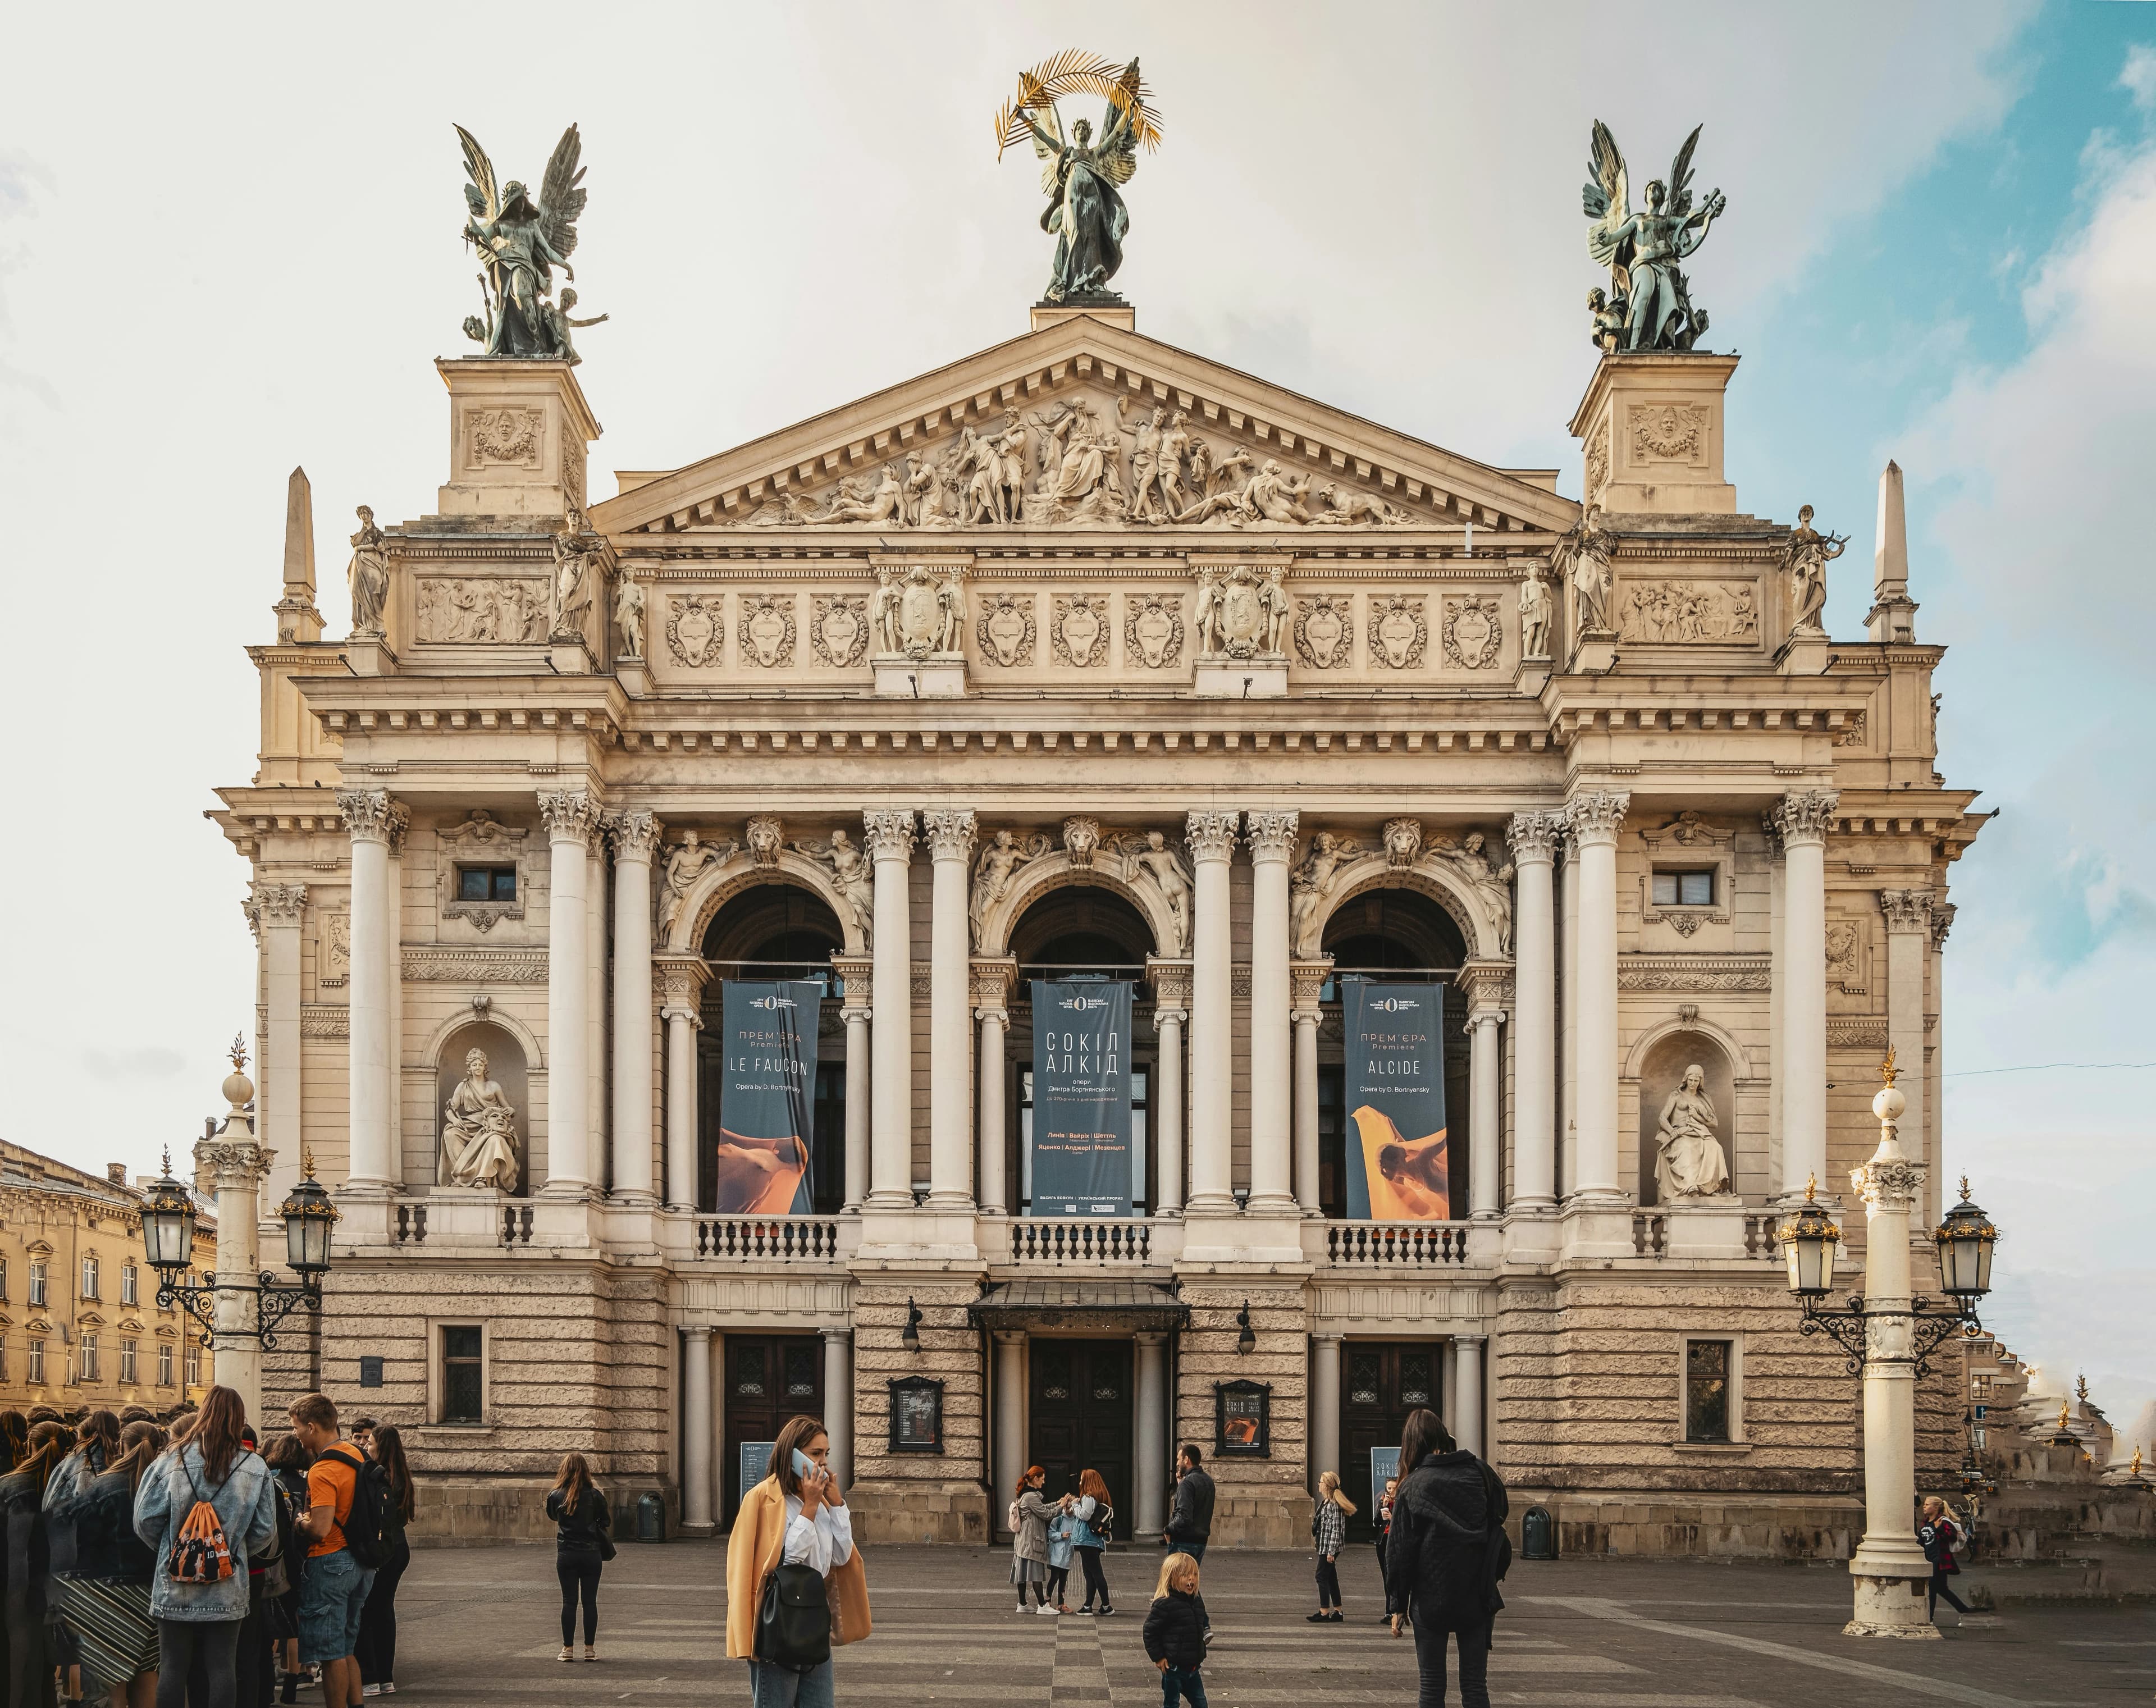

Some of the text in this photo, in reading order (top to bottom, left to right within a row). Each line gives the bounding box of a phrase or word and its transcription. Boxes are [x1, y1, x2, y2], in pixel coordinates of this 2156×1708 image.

[1047, 1032, 1117, 1052] СОКІЛ
[1360, 1034, 1427, 1042] ПРЕМ'ЄРА
[730, 1057, 807, 1076] LE FAUCON
[1046, 1054, 1118, 1075] АЛКІД
[1368, 1060, 1420, 1074] ALCIDE
[176, 1550, 182, 1558] 2
[207, 1550, 214, 1559] 10
